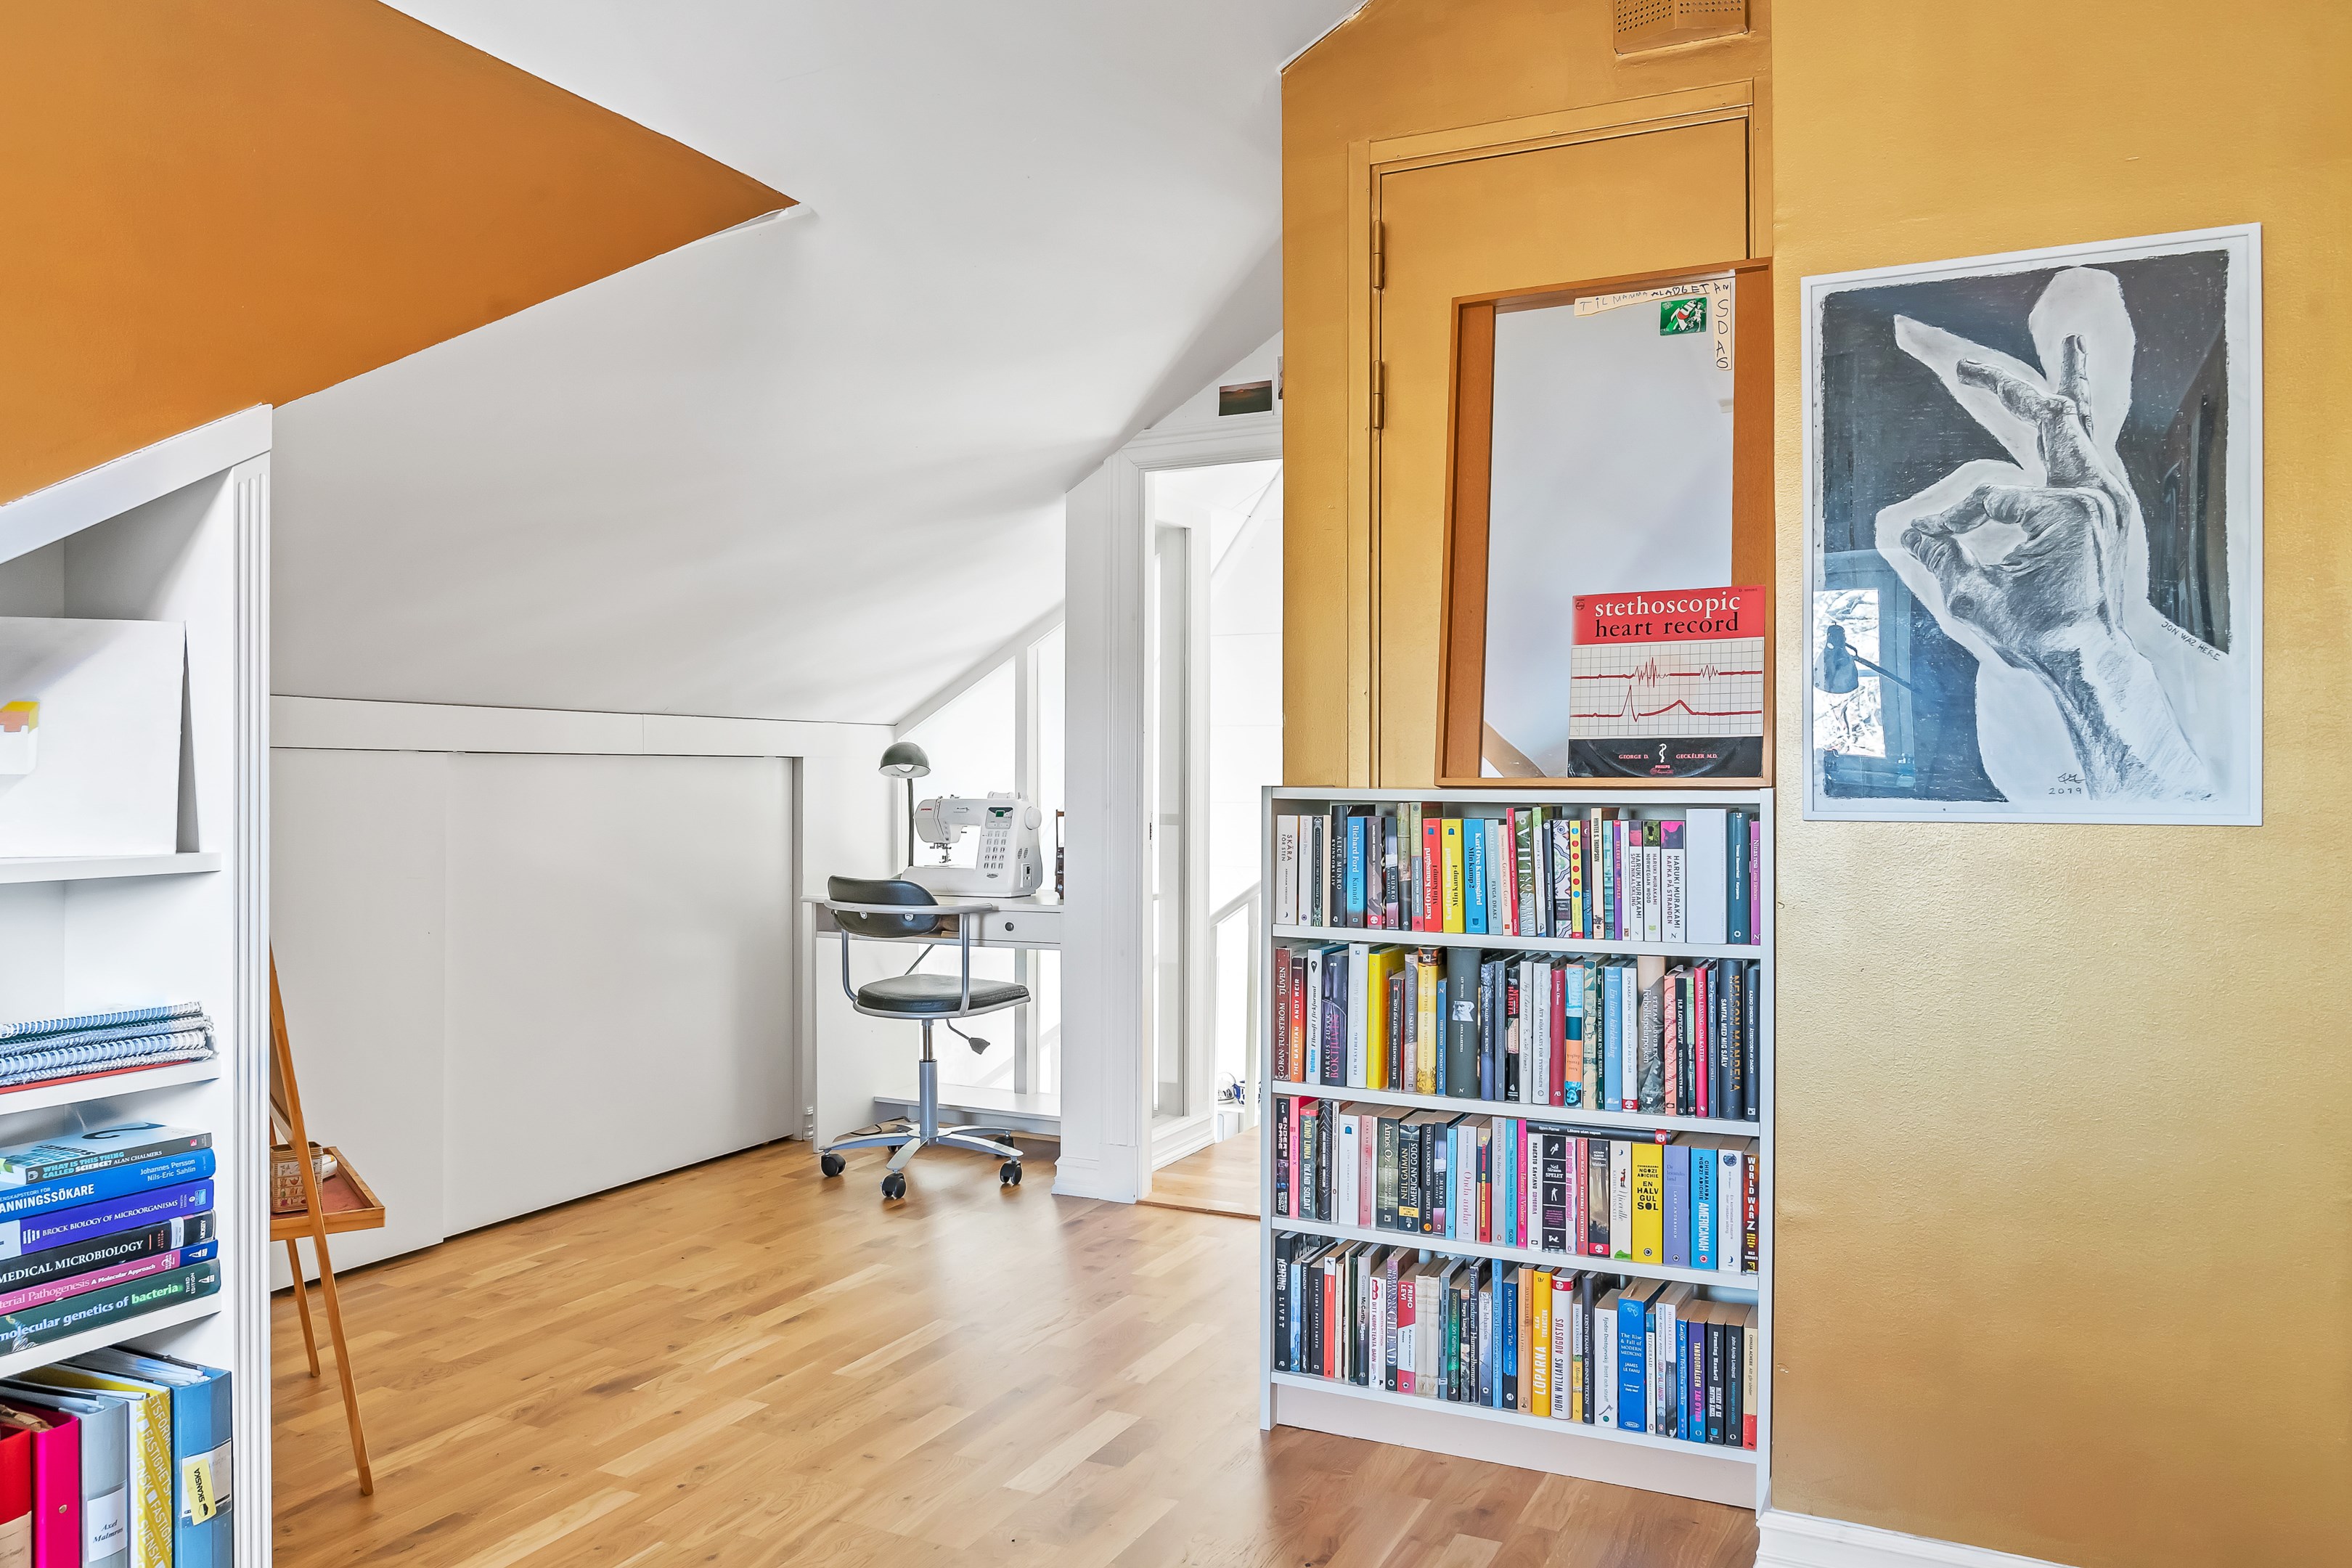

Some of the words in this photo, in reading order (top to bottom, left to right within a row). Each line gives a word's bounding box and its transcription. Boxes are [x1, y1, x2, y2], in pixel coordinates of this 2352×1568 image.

[1595, 591, 1741, 619] stethoscopic
[1596, 618, 1652, 637] heart
[1664, 611, 1739, 634] record
[1516, 826, 1532, 873] LILA
[1667, 879, 1674, 888] PÅ
[1609, 989, 1617, 1000] En
[1729, 975, 1740, 1026] NELSON
[1641, 989, 1652, 1063] Fotbollsspelarpojken
[1699, 1029, 1704, 1039] OM
[1729, 1030, 1740, 1092] MANDELA
[1304, 1119, 1312, 1138] VÄINÖ
[42, 1162, 69, 1173] WHAT
[99, 1151, 124, 1162] THING
[42, 1167, 74, 1179] CALLED
[75, 1160, 113, 1173] SCIENCE?
[131, 1151, 163, 1162] CHALMERS
[139, 1164, 169, 1175] Johannes
[171, 1159, 195, 1169] Persson
[1384, 1149, 1392, 1162] Oz
[147, 1170, 175, 1182] Nils-Eric
[176, 1167, 196, 1175] Sahlin
[1303, 1164, 1312, 1185] OKÄND
[1463, 1172, 1471, 1196] Onda
[1747, 1156, 1756, 1198] WORLD
[0, 1184, 94, 1214] ANNINGSSÖKARE
[1637, 1201, 1659, 1211] SOL
[1747, 1196, 1756, 1220] WAR
[42, 1225, 69, 1237] BROCK
[70, 1217, 102, 1230] BIOLOGY
[103, 1214, 113, 1223] OF
[114, 1199, 178, 1220] MICROORGANISMS
[1699, 1202, 1709, 1251] AMERICANAH
[1746, 1220, 1756, 1230] Z
[0, 1263, 53, 1283] MEDICAL
[55, 1240, 144, 1270] MICROBIOLOGY
[0, 1294, 25, 1308] terial
[28, 1279, 90, 1302] Pathogenesis
[98, 1270, 126, 1284] Molecular
[128, 1264, 155, 1276] Approach
[63, 1300, 114, 1327] genetics
[116, 1297, 129, 1308] of
[131, 1283, 179, 1305] bacteria
[1387, 1310, 1397, 1364] GILEAD
[1555, 1318, 1564, 1354] AUGUSTUS
[1533, 1347, 1546, 1395] LÖPARNA
[1555, 1358, 1564, 1392] WILLIAMS
[1554, 1395, 1564, 1411] JOHN
[194, 1467, 205, 1503] SKANSKA
[102, 1519, 118, 1531] Axel
